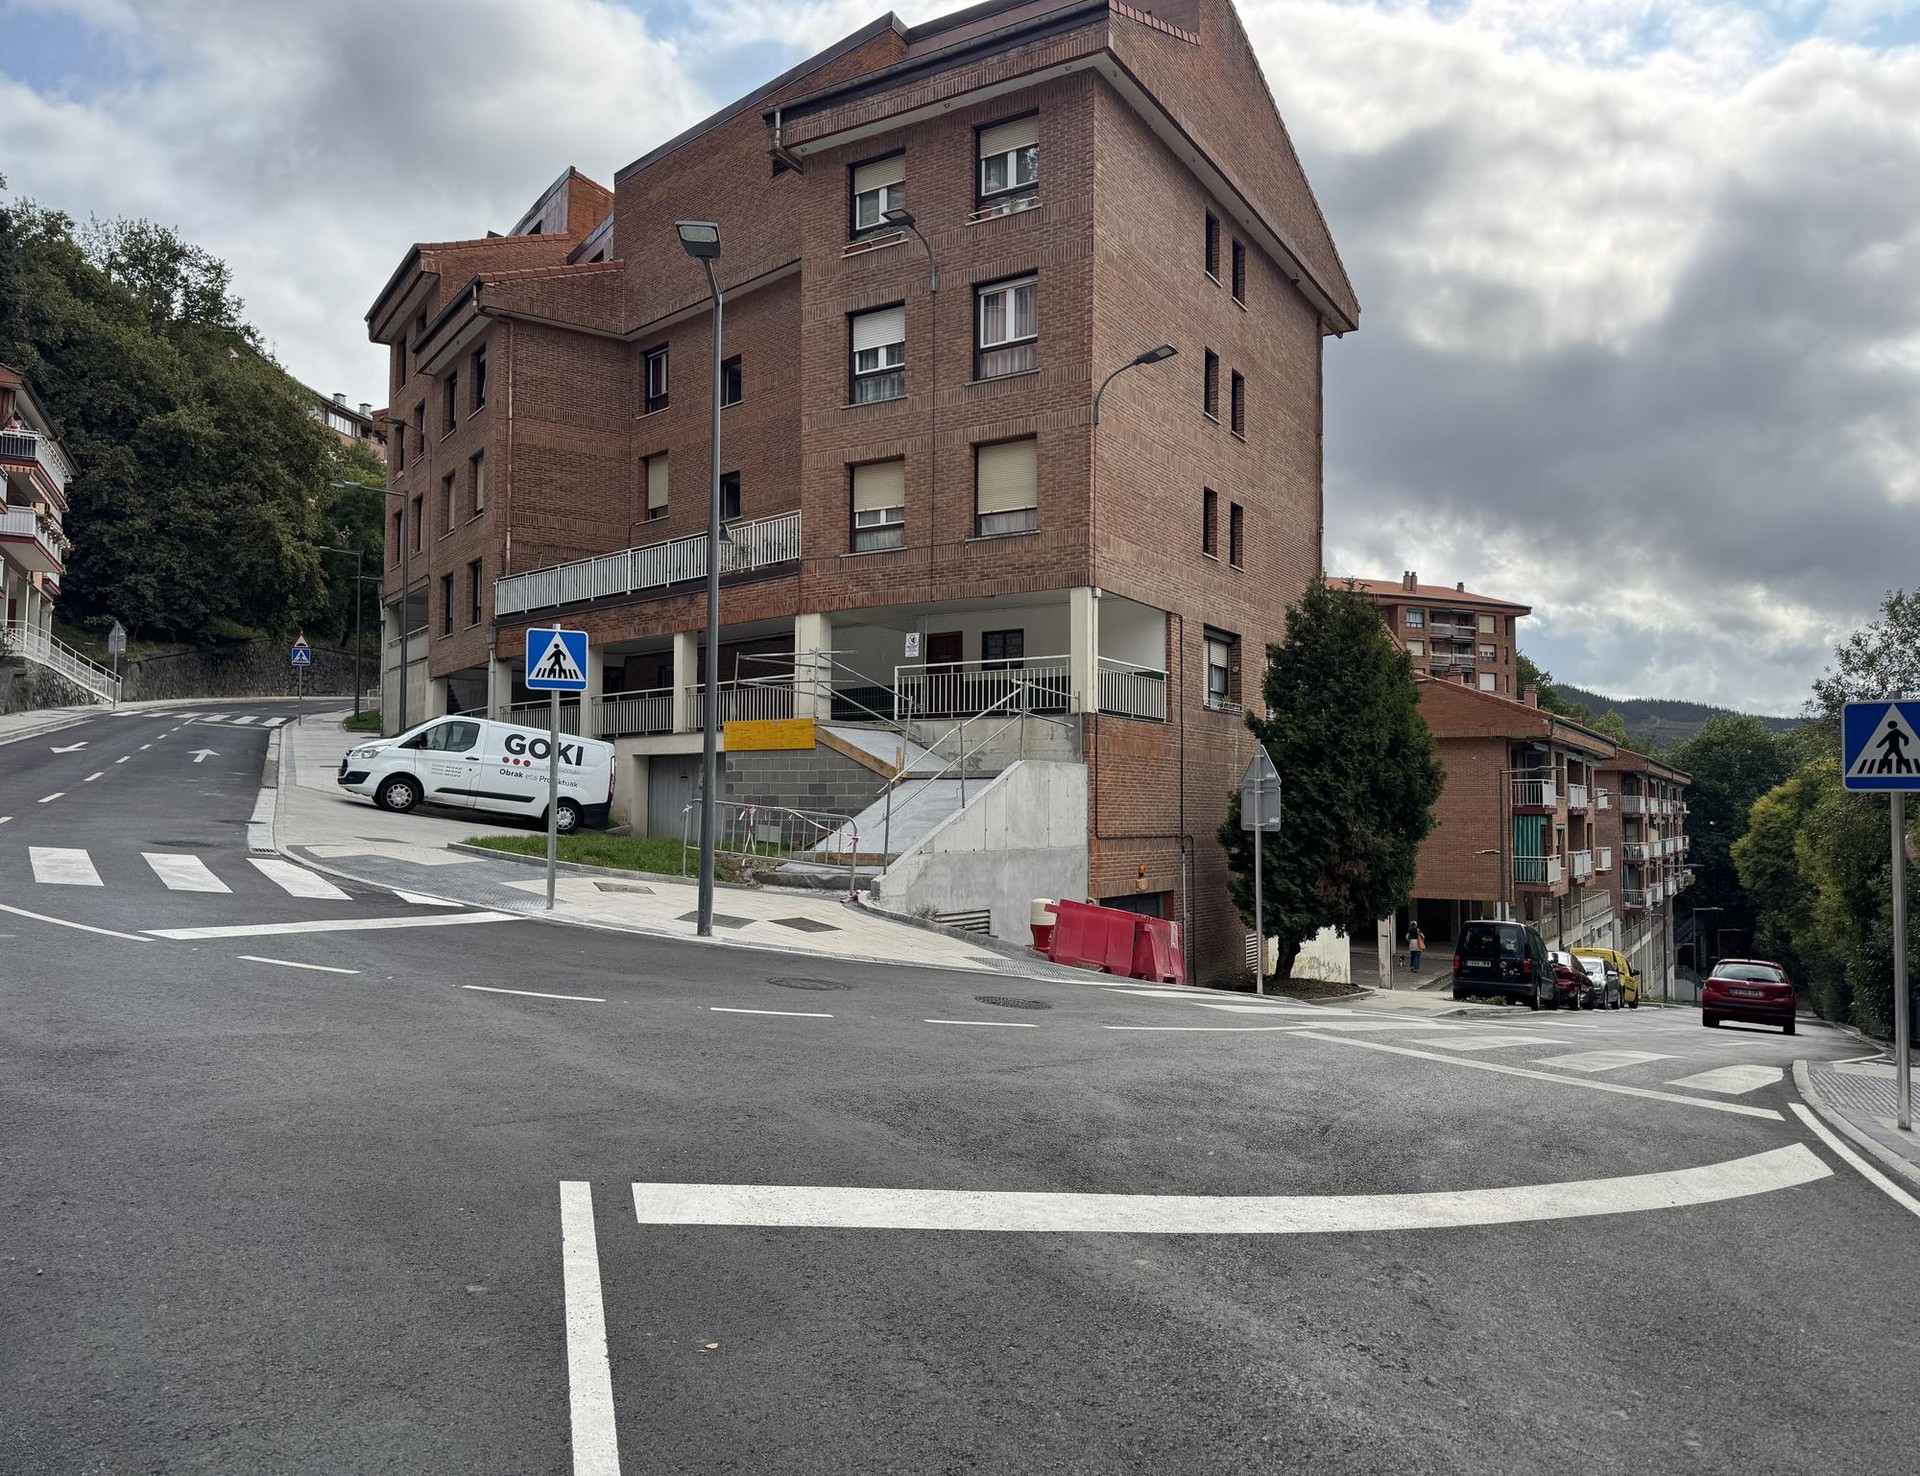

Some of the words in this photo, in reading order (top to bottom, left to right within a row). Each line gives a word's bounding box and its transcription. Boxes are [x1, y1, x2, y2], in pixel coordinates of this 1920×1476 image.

[504, 733, 584, 767] GOKI
[499, 768, 523, 779] Obrak
[525, 773, 538, 781] eta
[538, 775, 578, 788] Proktuak
